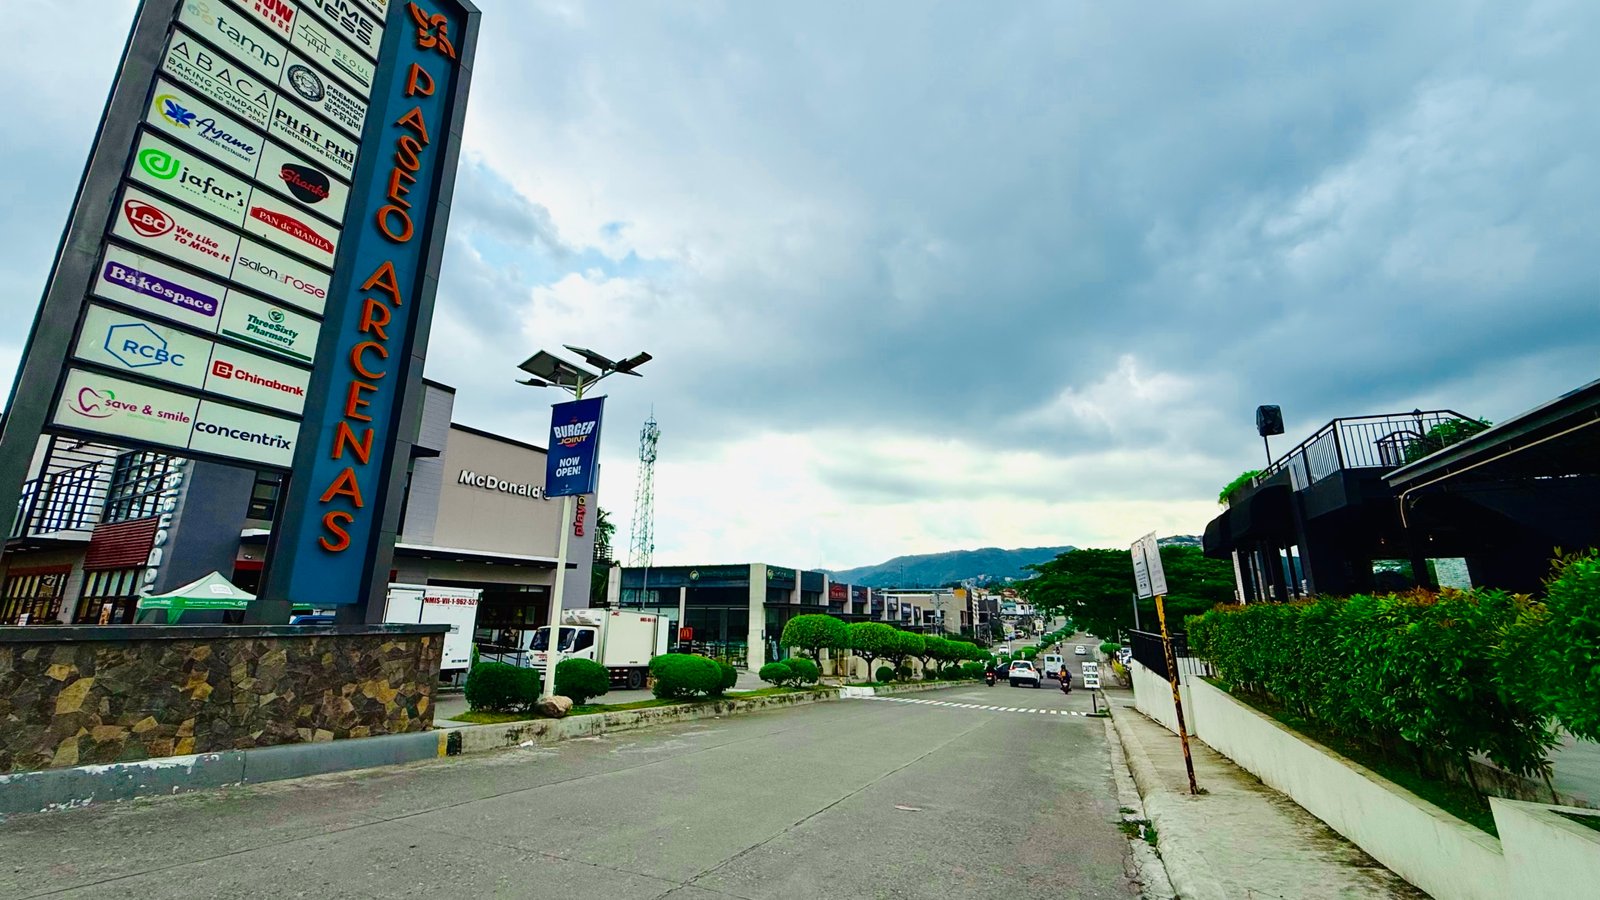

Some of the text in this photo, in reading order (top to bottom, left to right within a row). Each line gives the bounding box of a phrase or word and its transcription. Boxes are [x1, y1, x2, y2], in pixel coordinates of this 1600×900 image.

[335, 48, 370, 78] SEOUL
[166, 65, 265, 126] HANDCRAFTED SINCE 2006
[168, 57, 267, 119] BAKING COMPANY
[327, 84, 365, 114] PREMIUM
[326, 91, 364, 118] GWANGSOO
[328, 98, 360, 122] DAKGALBI
[195, 118, 256, 155] Ayame
[197, 132, 251, 162] JAPANESE RESTAURANT
[280, 125, 324, 155] vietnamese
[325, 151, 352, 171] kitchen
[375, 62, 436, 243] PASEO
[179, 167, 244, 207] jafar's
[130, 208, 166, 230] LBC
[259, 210, 279, 226] PAN
[280, 222, 292, 231] de
[293, 227, 329, 250] MANILA
[174, 233, 231, 263] To Move It
[176, 225, 219, 249] We Like
[238, 256, 278, 280] salon
[284, 275, 325, 299] rose
[246, 323, 295, 346] Pharmacy
[247, 314, 299, 339] ThreeSixty
[122, 339, 185, 367] RCBC
[234, 369, 304, 397] Chinabank
[104, 397, 138, 413] save
[142, 404, 153, 416] &
[157, 409, 191, 424] smile
[317, 260, 403, 552] ARCENAS
[194, 422, 292, 450] concentrix
[553, 421, 596, 438] BURGER
[557, 435, 588, 445] JOINT
[556, 465, 581, 477] OPEN!
[559, 456, 580, 467] NOW
